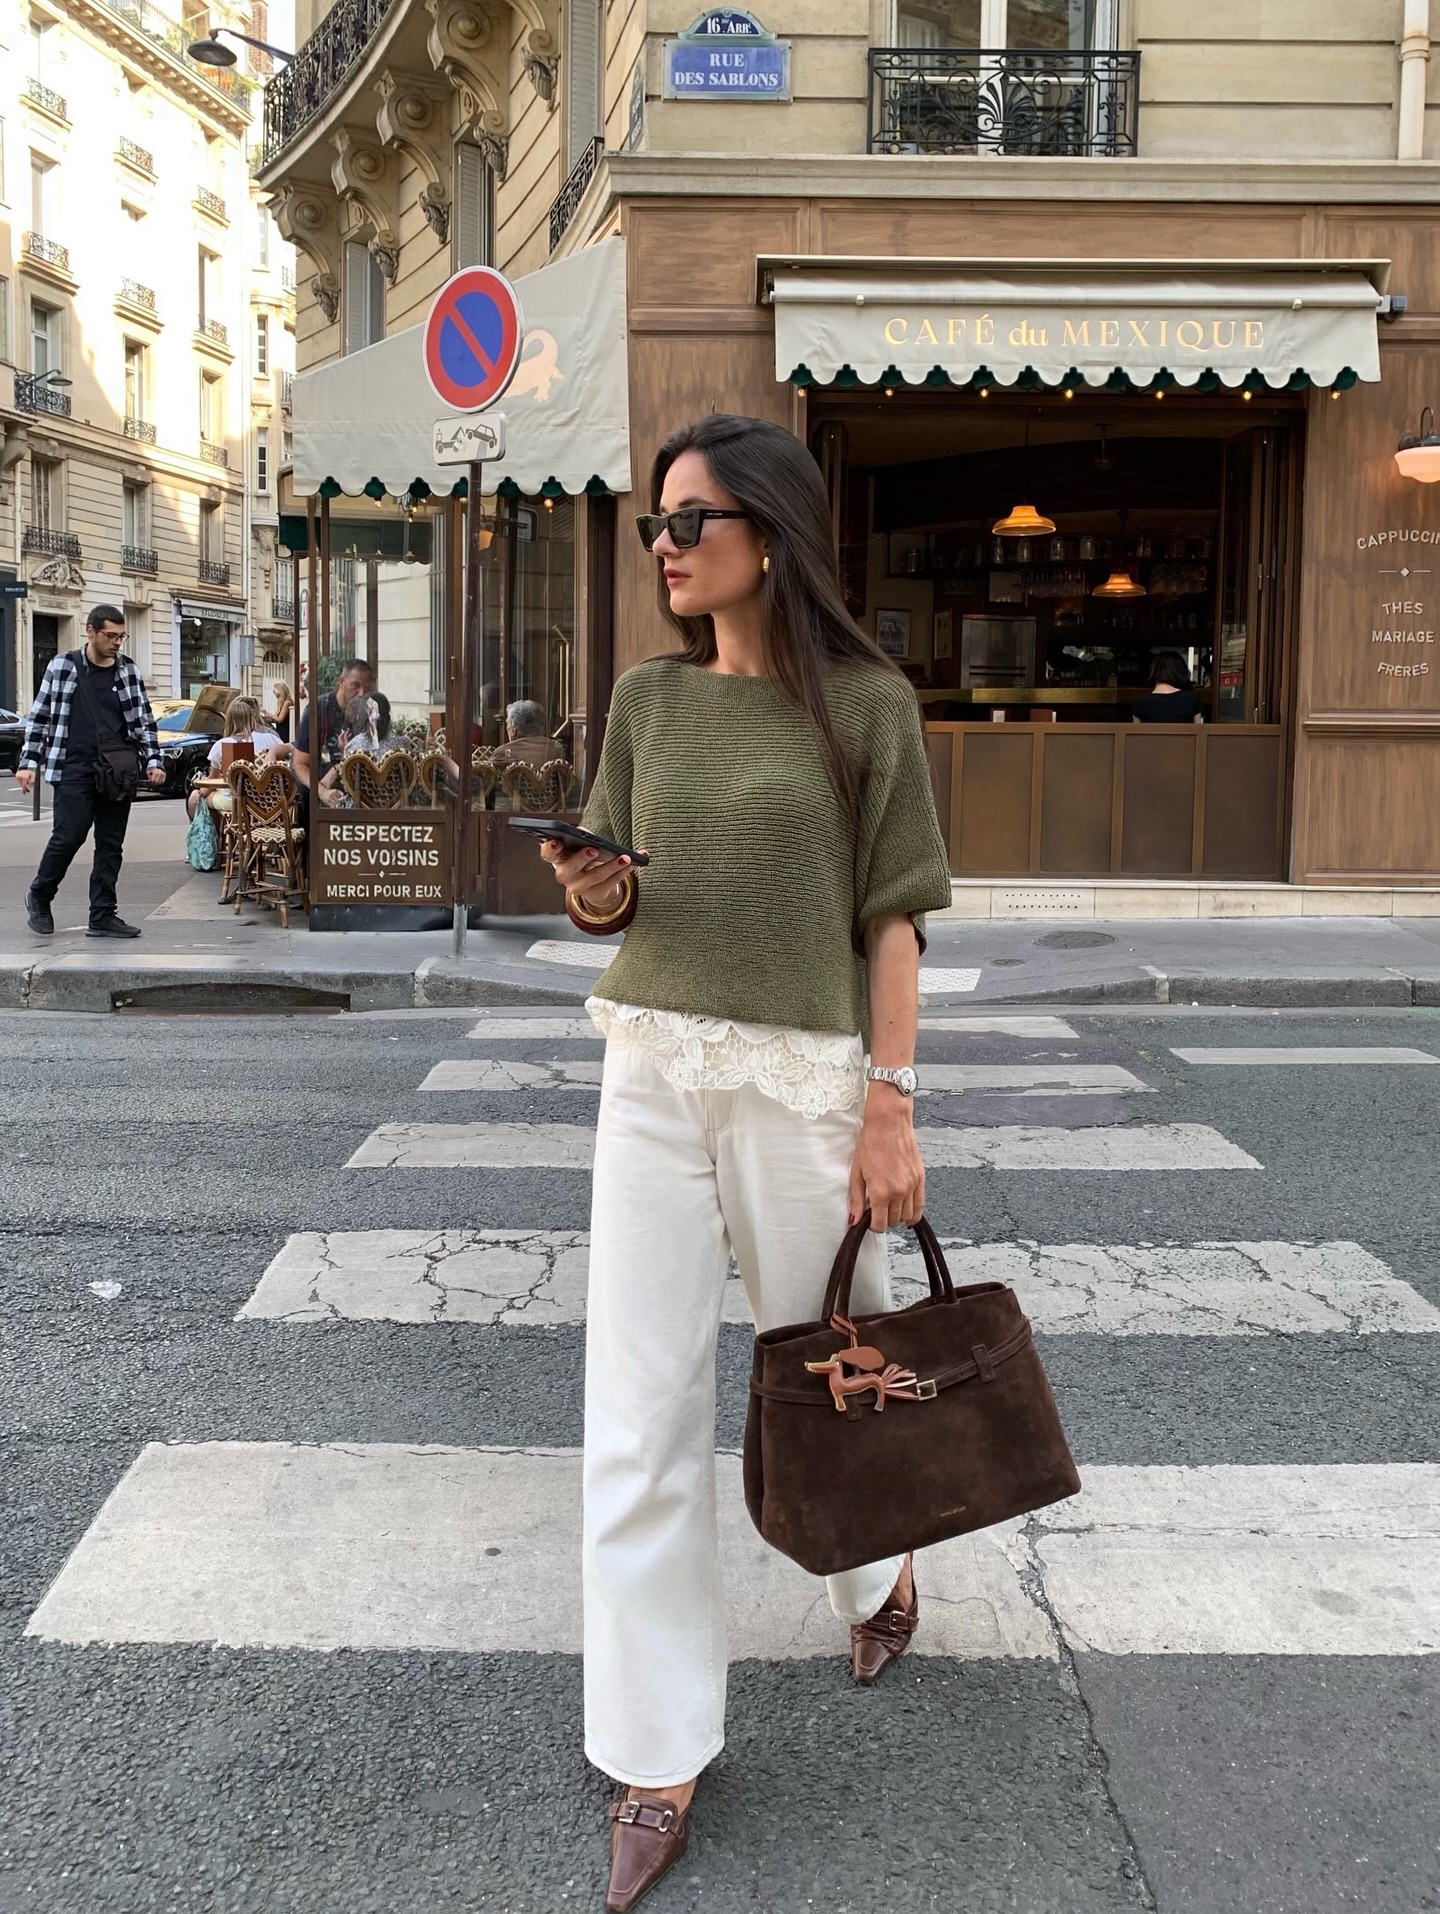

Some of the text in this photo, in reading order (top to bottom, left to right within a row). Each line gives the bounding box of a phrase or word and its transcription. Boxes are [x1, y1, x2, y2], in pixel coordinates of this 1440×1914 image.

[709, 53, 744, 67] RUE
[674, 71, 778, 86] DES SABLONS
[884, 313, 1265, 353] CAFÉ du MEXIQUE
[1372, 630, 1435, 643] MARIAGE
[329, 824, 433, 842] RESPECTEZ
[323, 848, 439, 866] NOS VOISINS
[326, 884, 442, 898] MERCI POUR EUX
